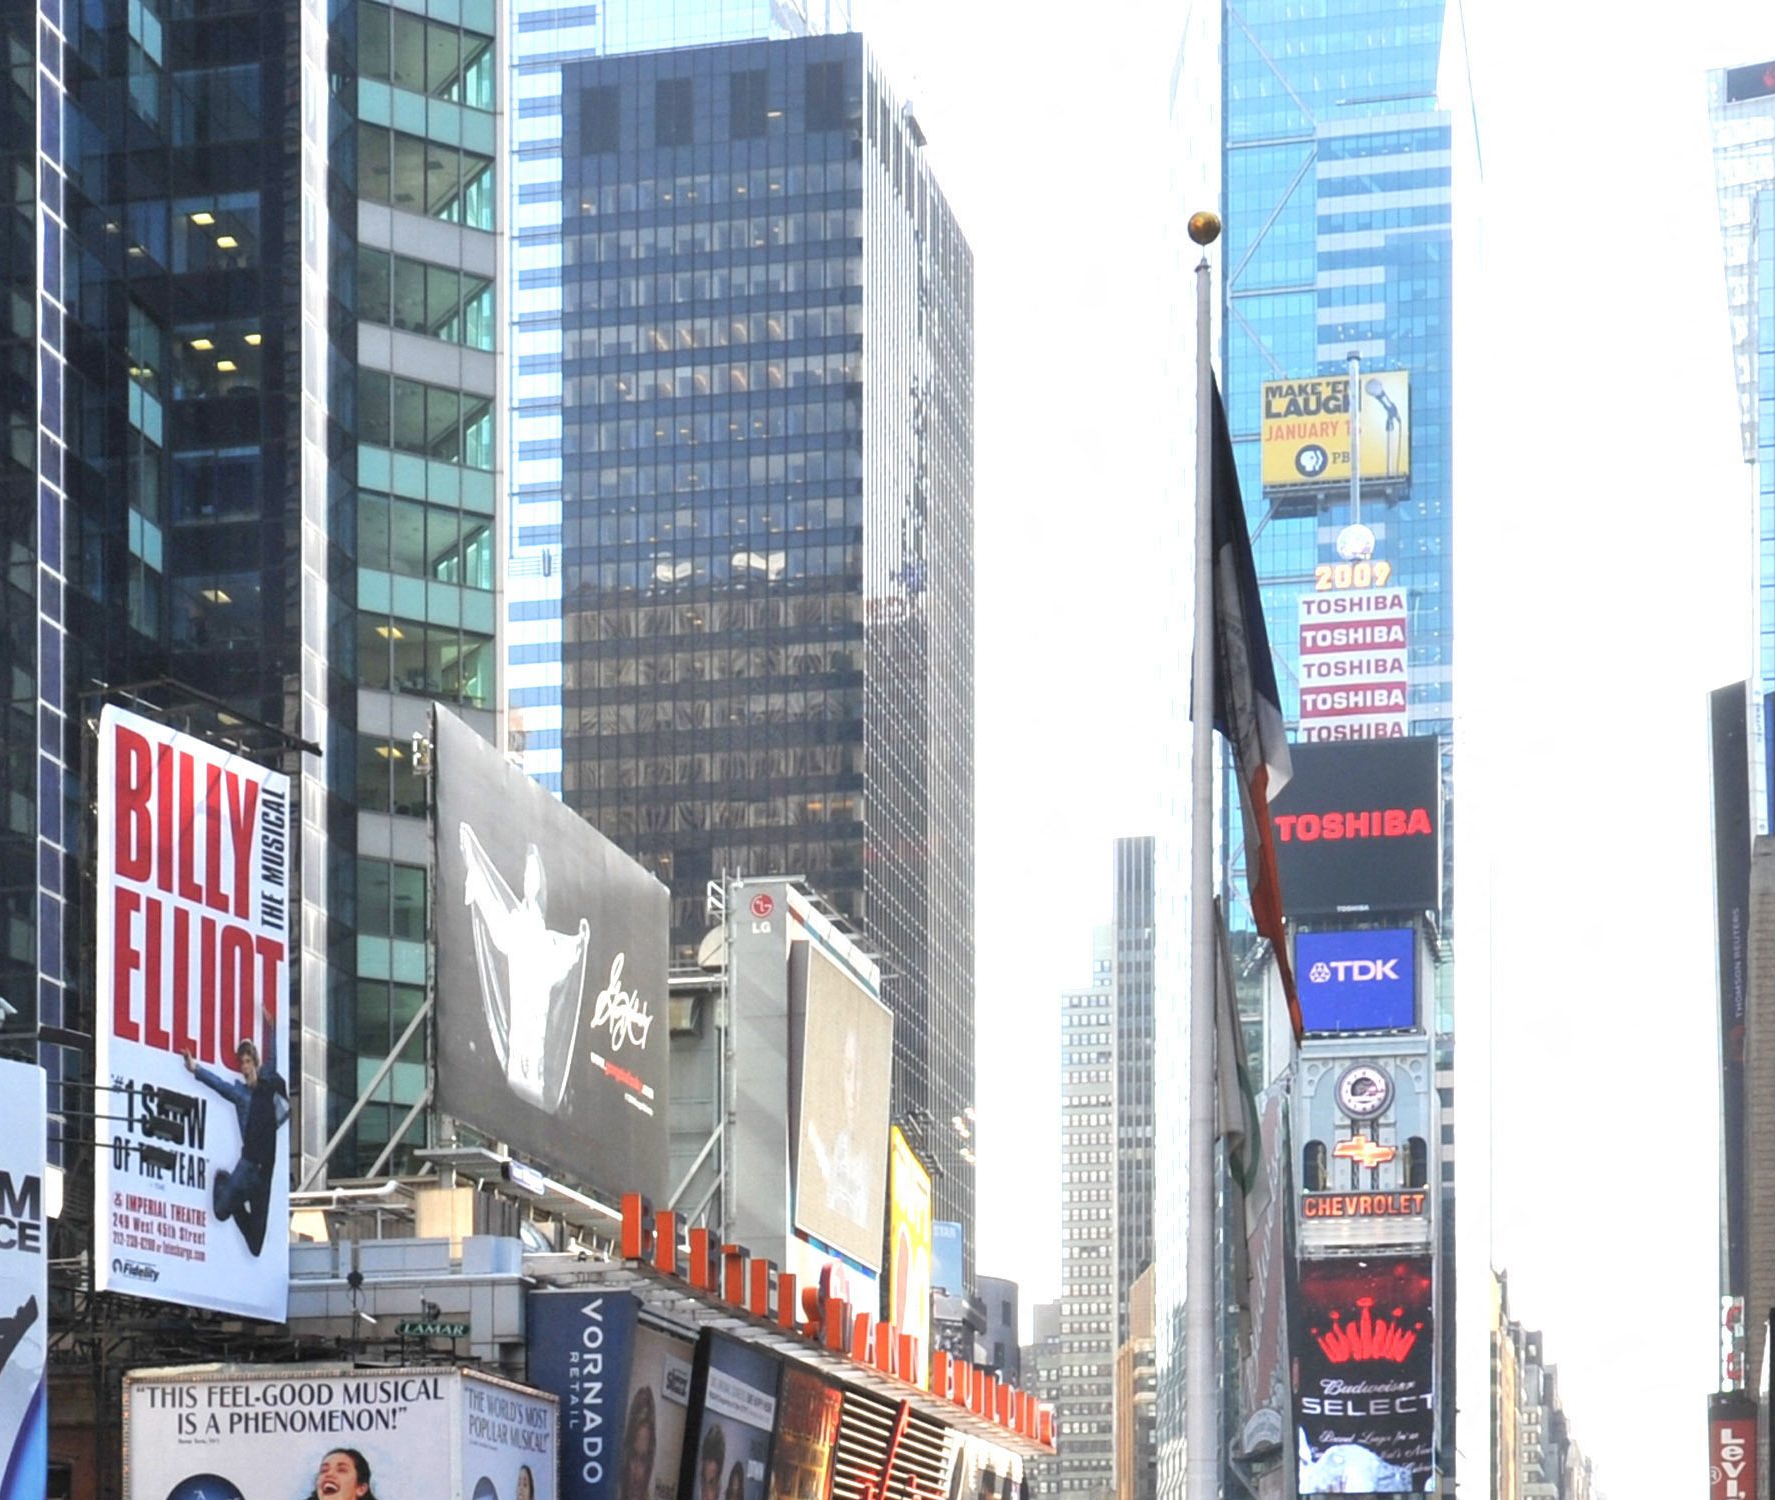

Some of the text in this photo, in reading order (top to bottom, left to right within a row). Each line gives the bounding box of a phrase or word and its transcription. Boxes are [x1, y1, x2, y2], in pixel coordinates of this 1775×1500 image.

[1265, 383, 1322, 399] MAKE
[1265, 421, 1339, 442] JANUARY
[1315, 561, 1391, 591] 2009
[1303, 594, 1404, 616] TOSHIBA
[1303, 624, 1405, 648] TOSHIBA
[1303, 658, 1405, 680] TOSHIBA
[1303, 688, 1405, 712] TOSHIBA
[1303, 721, 1405, 743] TOSHIBA
[115, 724, 259, 922] BILLY
[1275, 809, 1432, 842] TOSHIBA
[261, 786, 285, 931] THE MUSICAL
[113, 886, 284, 1074] ELLIOT
[1330, 958, 1399, 982] TDK
[126, 1193, 206, 1228] IMPERIAL THEATRE
[1304, 1195, 1425, 1217] CHEVROLET
[405, 1323, 468, 1336] LAMAR
[136, 1378, 444, 1409] "THIS FEEL-GOOD MUSICAL
[569, 1351, 582, 1431] RETAIL
[581, 1296, 604, 1486] VORNADO
[1320, 1377, 1417, 1396] Budweiser
[1302, 1393, 1433, 1416] SELECT
[178, 1412, 221, 1435] IS A
